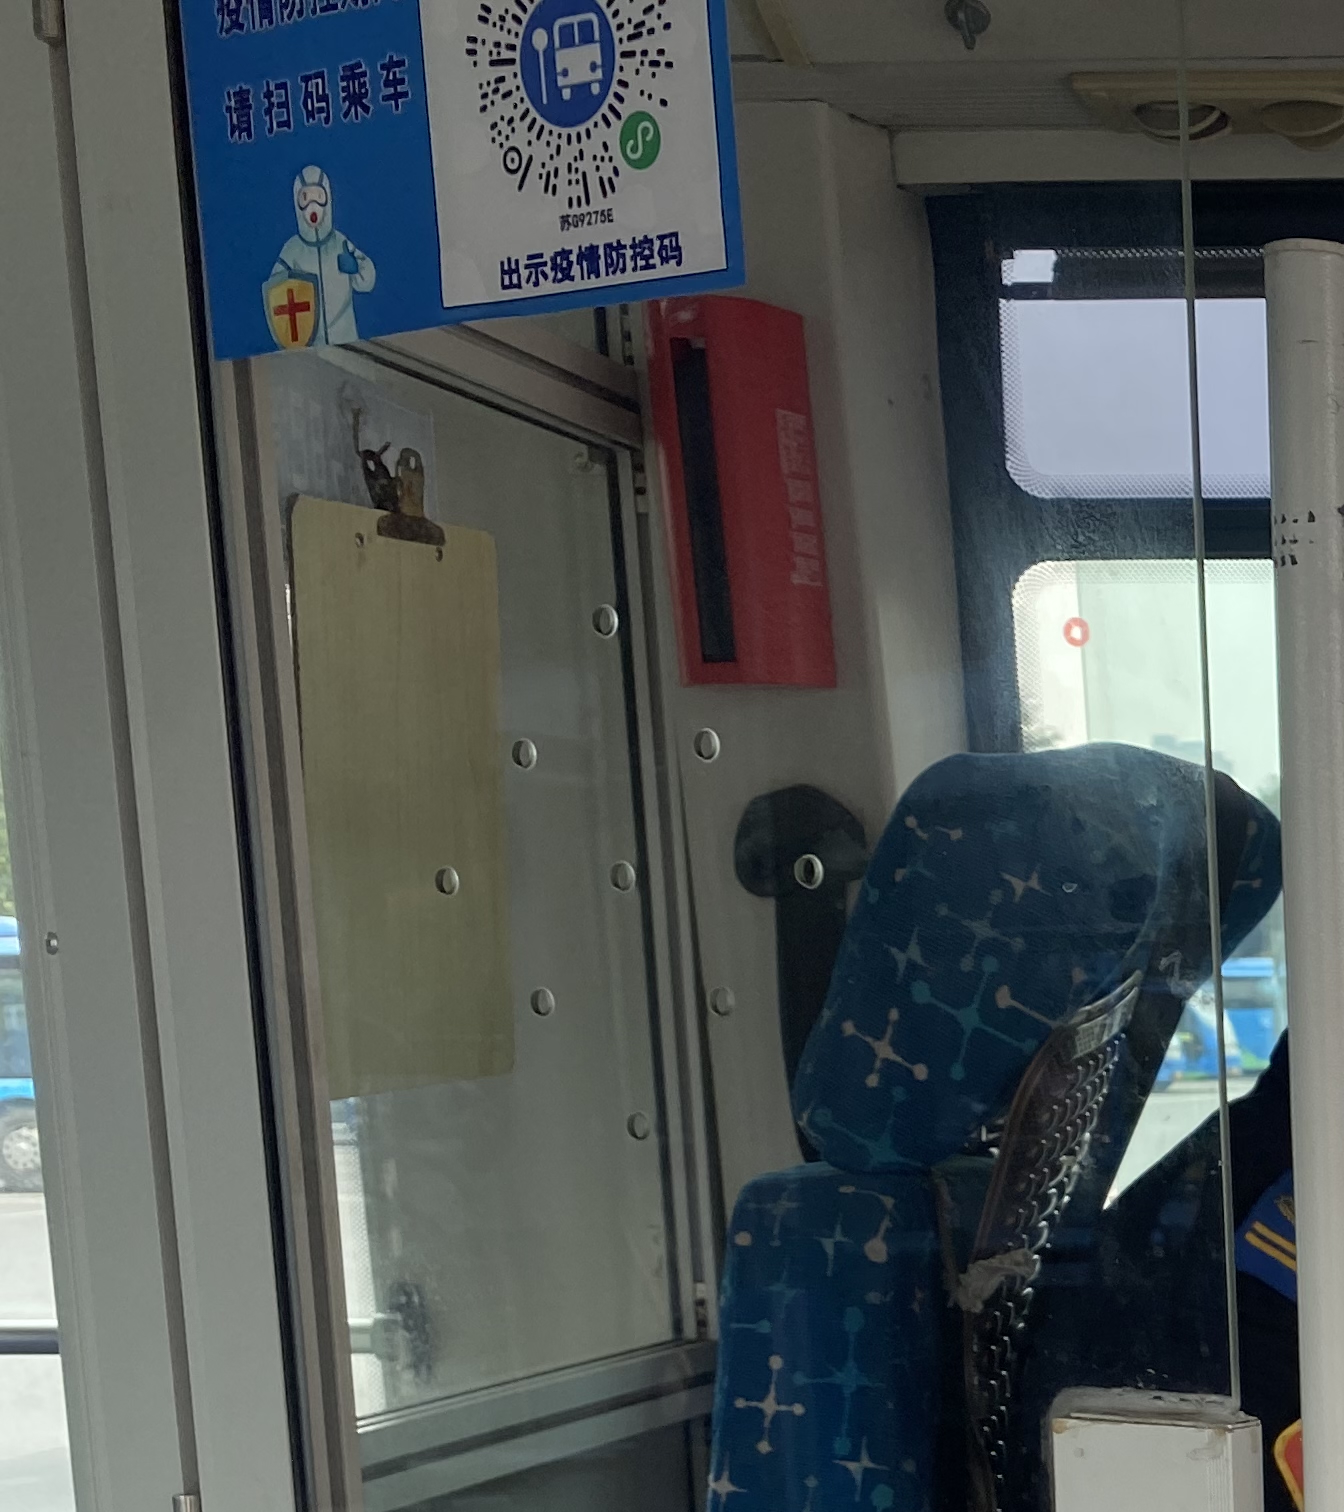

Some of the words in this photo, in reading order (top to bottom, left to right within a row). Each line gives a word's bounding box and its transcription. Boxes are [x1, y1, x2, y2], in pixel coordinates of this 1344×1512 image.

[224, 52, 411, 144] 请扫码乘车
[499, 231, 684, 291] 出示疫情防控码
